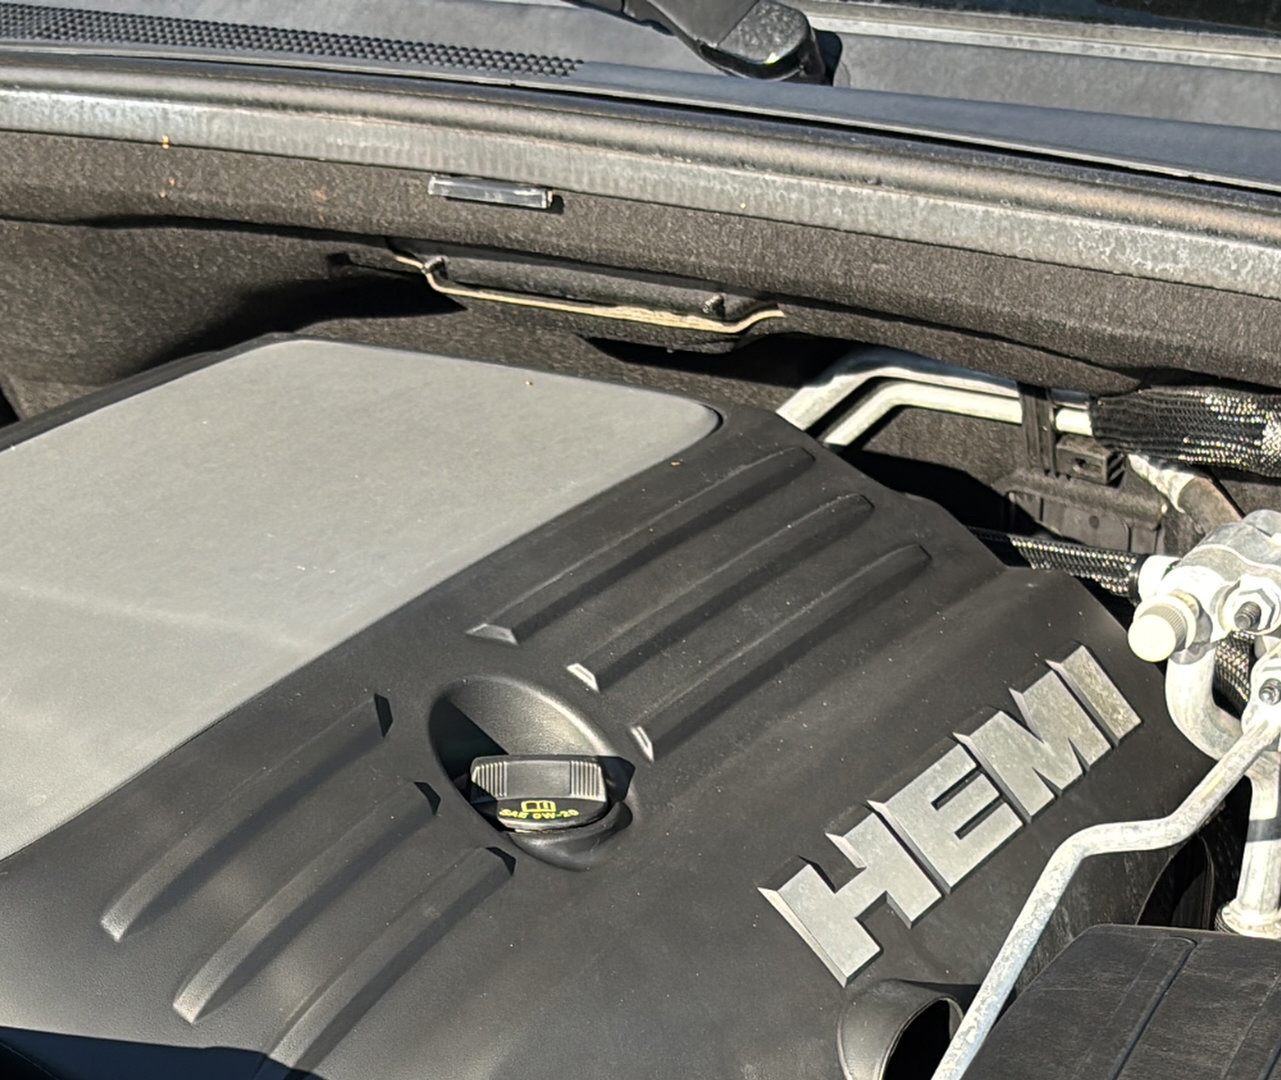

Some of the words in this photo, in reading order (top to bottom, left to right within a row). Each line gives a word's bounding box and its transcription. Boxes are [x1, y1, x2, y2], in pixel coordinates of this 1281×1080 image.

[499, 808, 529, 819] SAE
[532, 809, 579, 820] 0W-20
[757, 642, 1142, 988] HEMI
